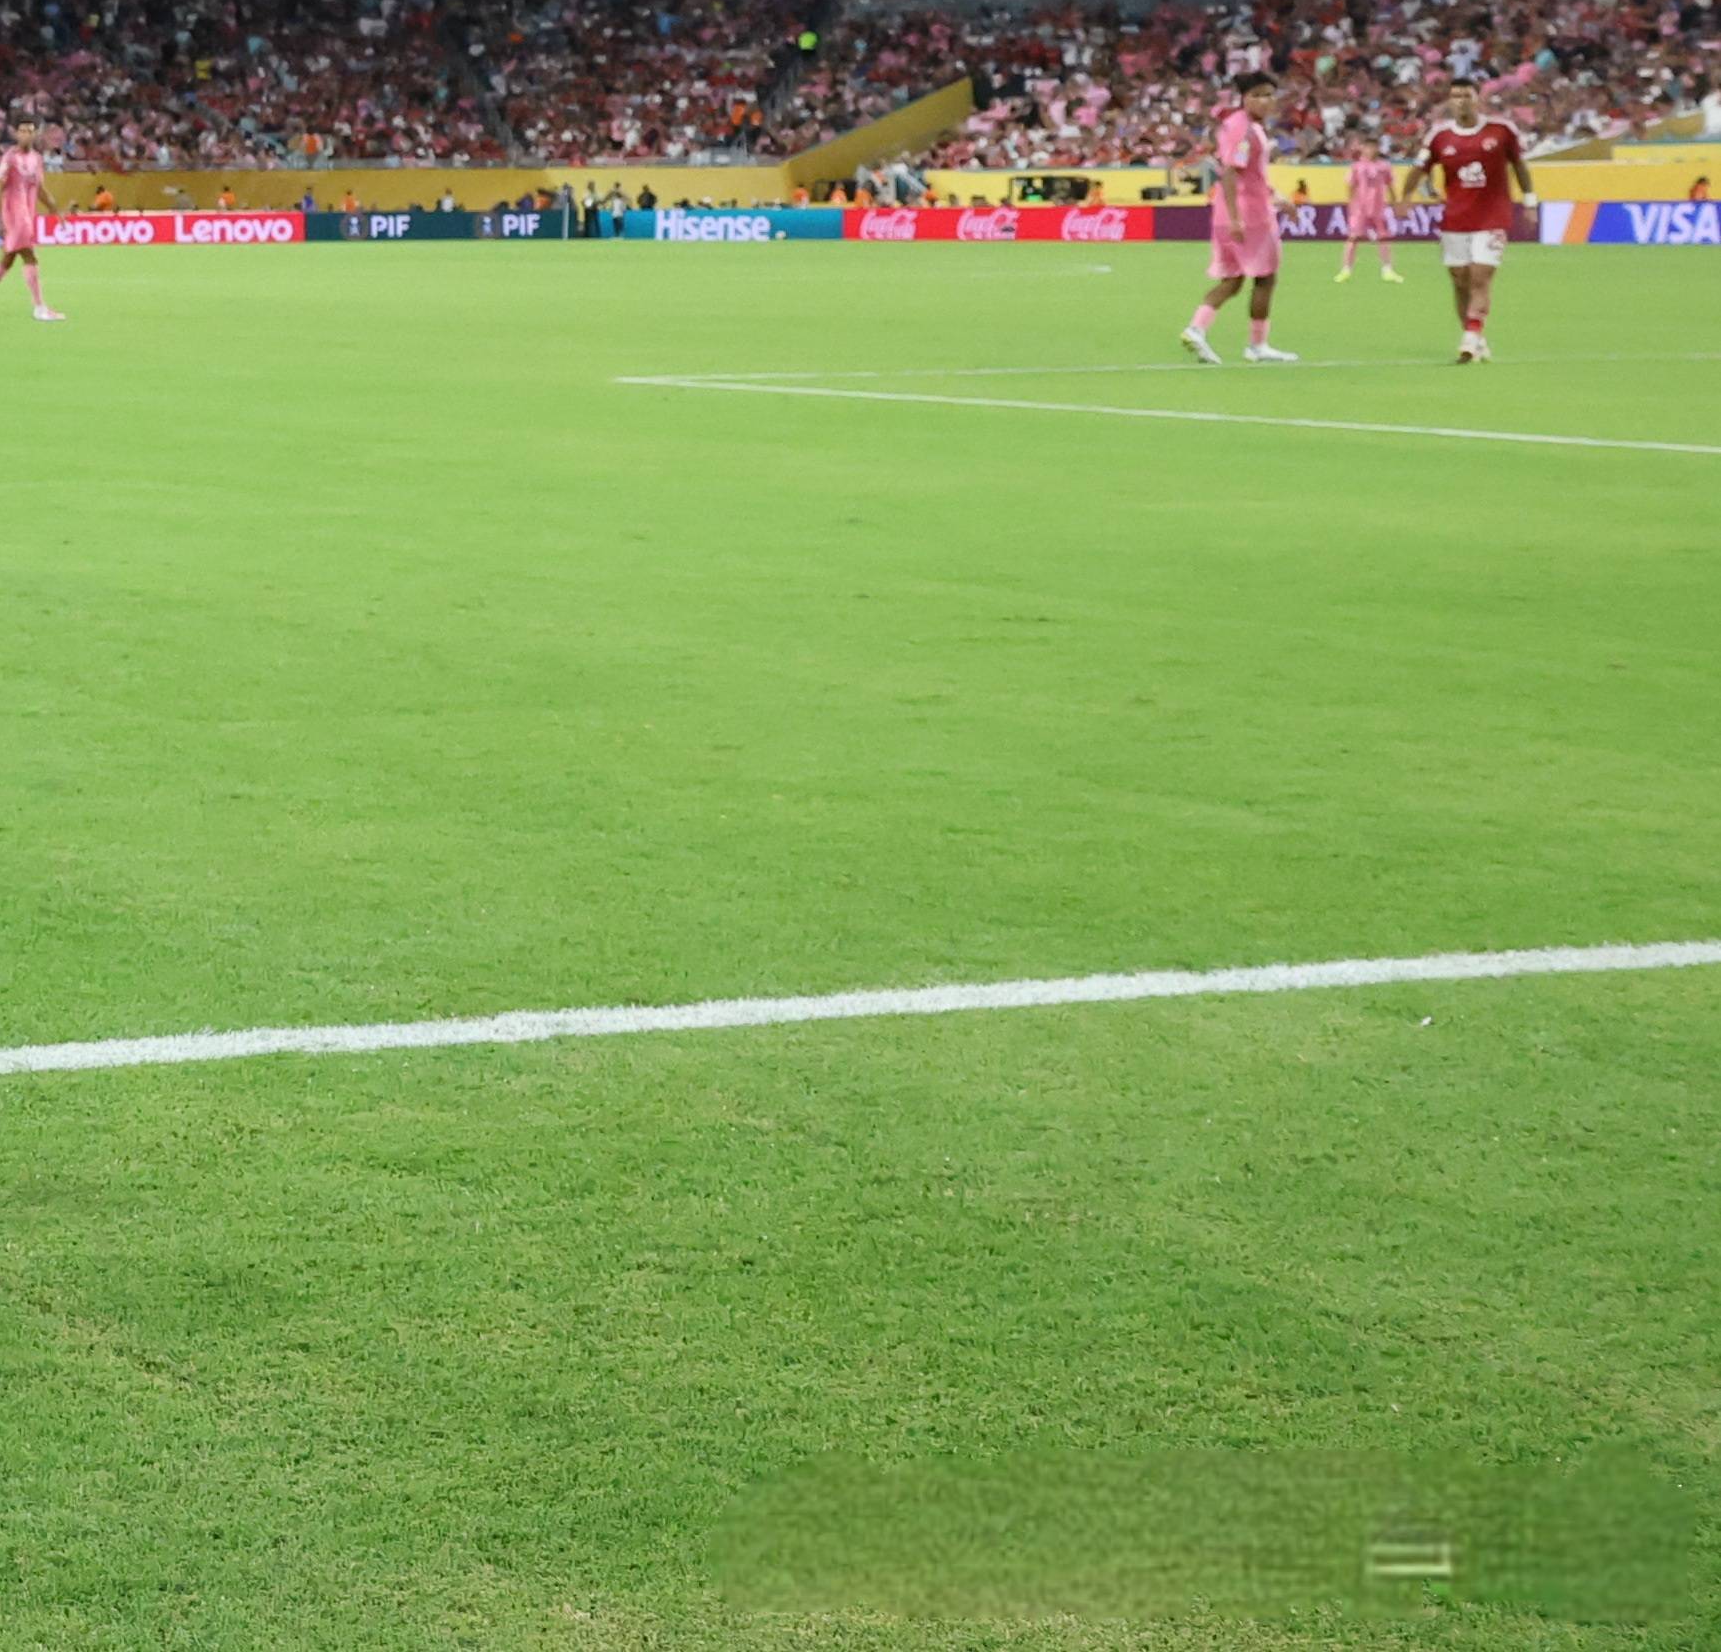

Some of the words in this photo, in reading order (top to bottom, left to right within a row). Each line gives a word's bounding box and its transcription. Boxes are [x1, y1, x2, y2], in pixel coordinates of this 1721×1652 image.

[37, 215, 155, 246] Lenovo
[174, 212, 294, 244] Lenovo
[370, 215, 411, 239] PIF
[502, 214, 541, 237] PIF
[655, 209, 770, 241] Hisense
[859, 209, 919, 240] Coca-Cola
[1060, 207, 1129, 241] Coca-Cola
[1622, 203, 1721, 241] VISA
